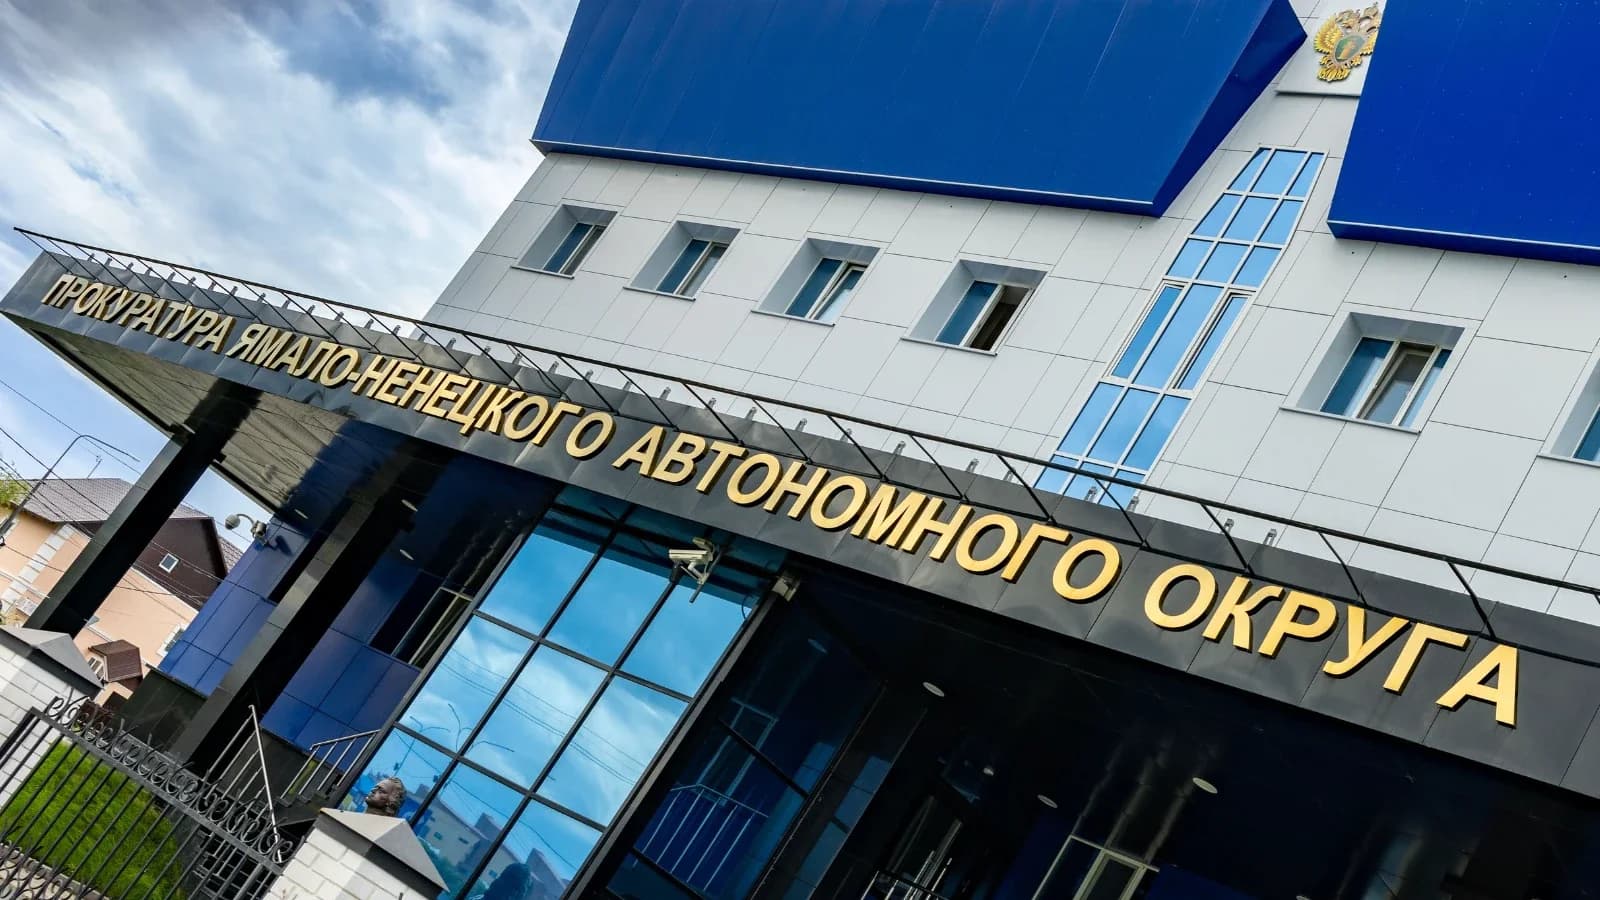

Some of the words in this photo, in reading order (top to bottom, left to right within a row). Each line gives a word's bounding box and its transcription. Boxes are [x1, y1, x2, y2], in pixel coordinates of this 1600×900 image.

[41, 273, 236, 354] ПРОКУРАТУРА
[226, 323, 614, 459] ЯМАЛО-НЕНЕЦКОГО
[613, 425, 1122, 602] АВТОНОМНОГО
[1144, 563, 1520, 728] ОКРУГА
